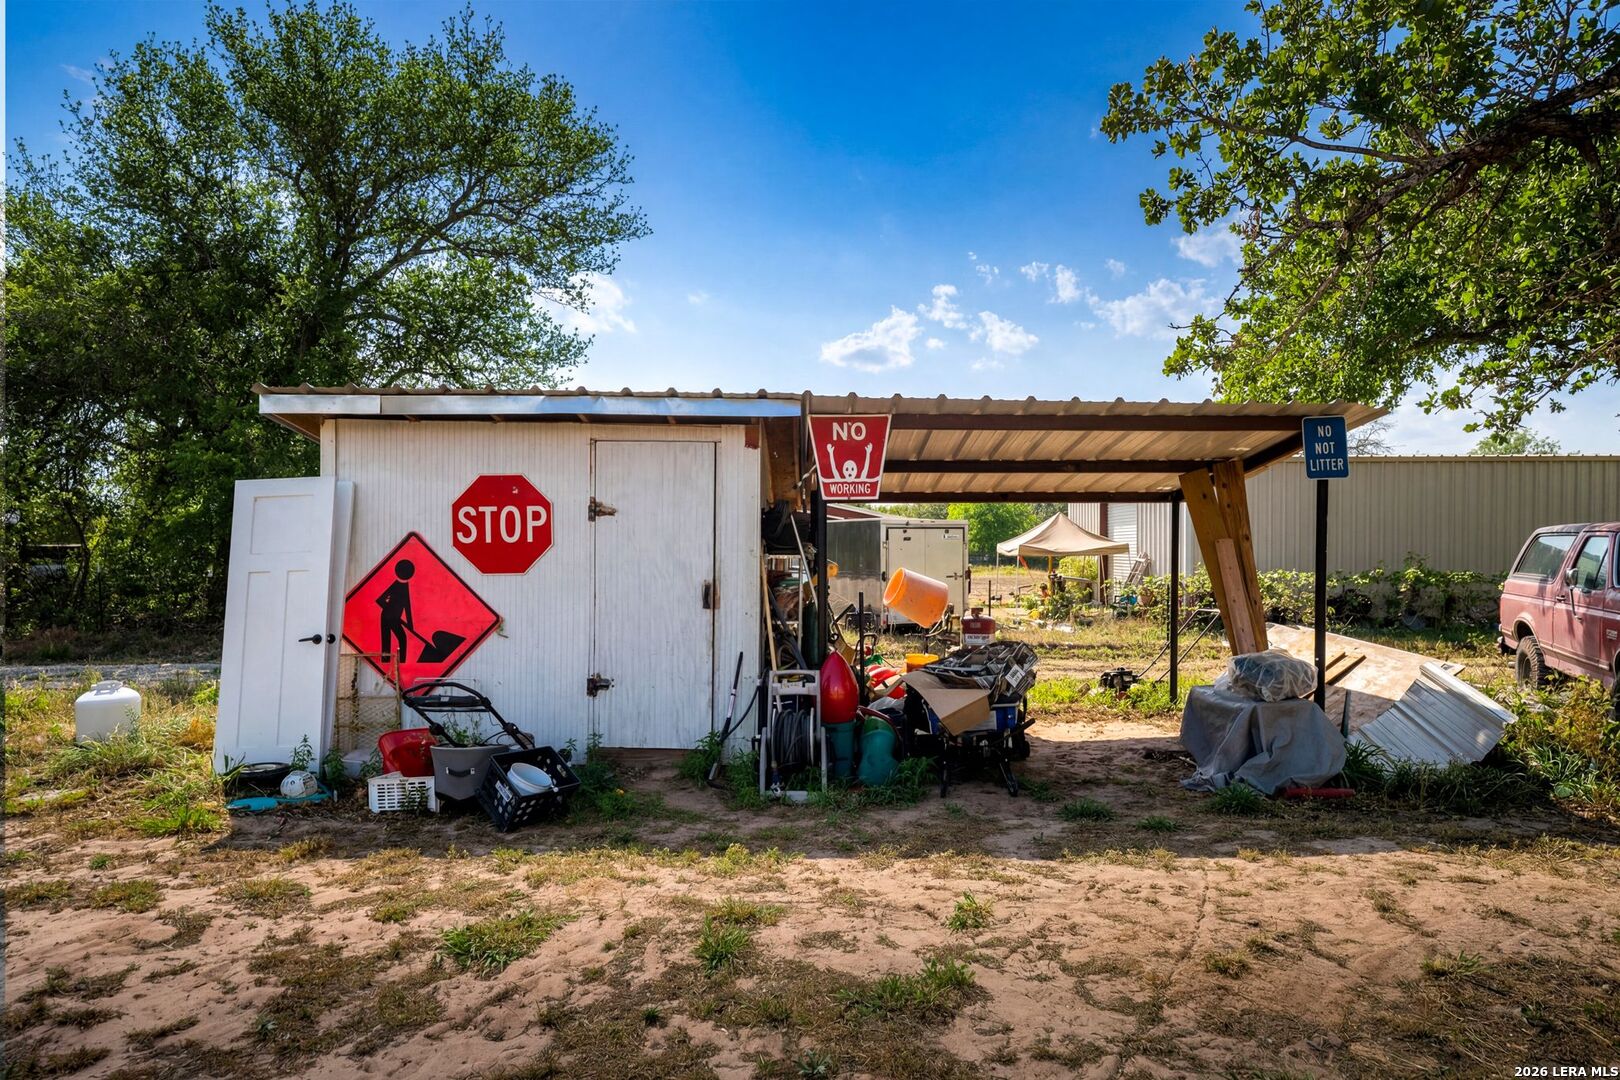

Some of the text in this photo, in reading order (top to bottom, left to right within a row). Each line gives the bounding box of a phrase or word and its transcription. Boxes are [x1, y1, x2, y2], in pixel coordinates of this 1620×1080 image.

[832, 422, 866, 441] NO
[1317, 425, 1332, 437] NO
[1315, 442, 1335, 454] NOT
[1310, 458, 1344, 471] LITTER
[830, 483, 871, 494] WORKING
[456, 505, 547, 544] STOP
